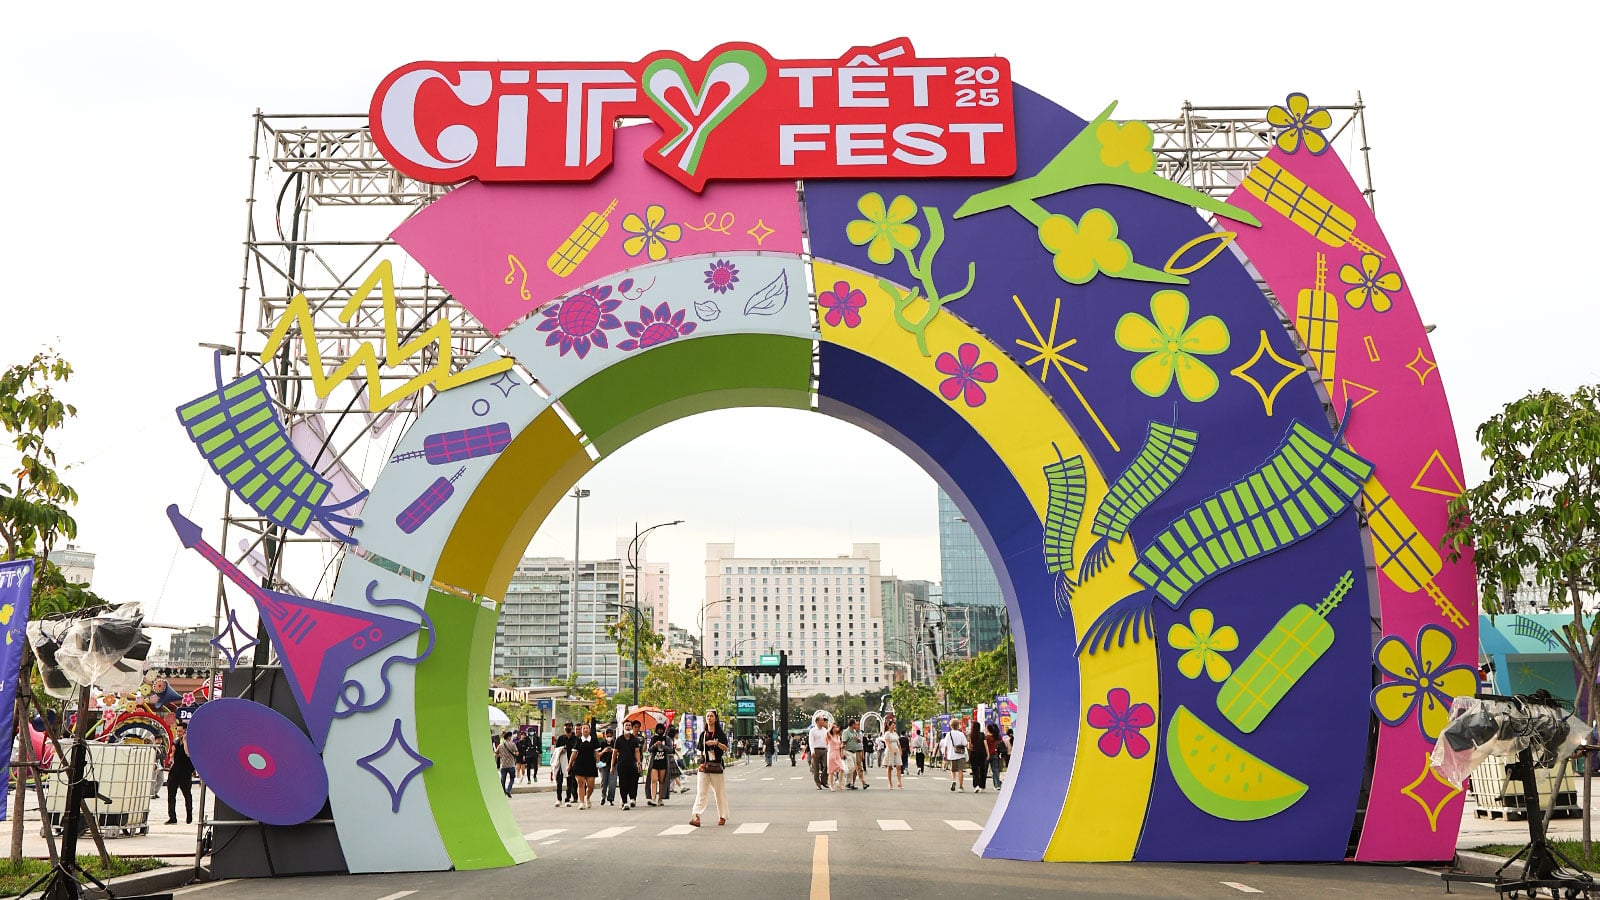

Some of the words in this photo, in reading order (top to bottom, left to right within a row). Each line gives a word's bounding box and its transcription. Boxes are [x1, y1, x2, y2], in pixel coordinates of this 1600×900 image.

[778, 45, 947, 109] TẾT
[954, 66, 1001, 85] 20
[955, 88, 1000, 107] 25
[778, 123, 1004, 166] FEST
